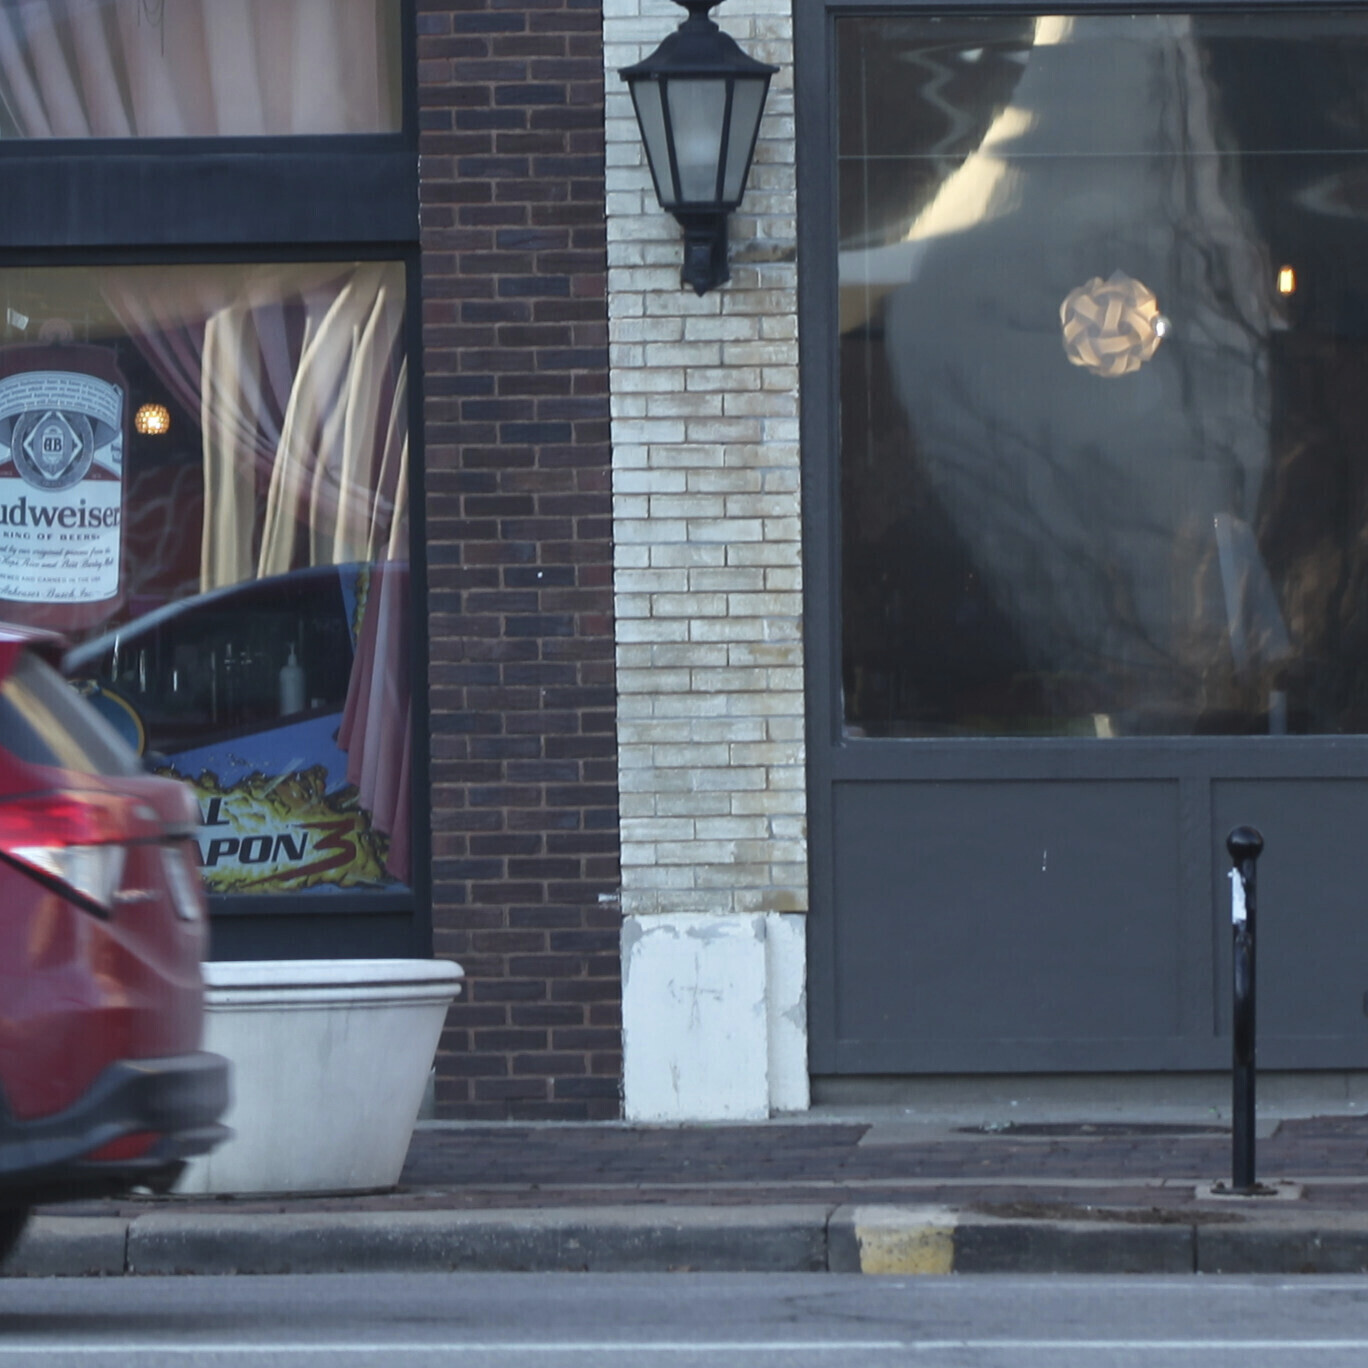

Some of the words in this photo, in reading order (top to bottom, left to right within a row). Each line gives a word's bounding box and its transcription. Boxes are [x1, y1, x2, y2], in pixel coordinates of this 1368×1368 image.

[2, 531, 31, 540] KING
[36, 531, 53, 540] OF
[196, 831, 308, 867] PON
